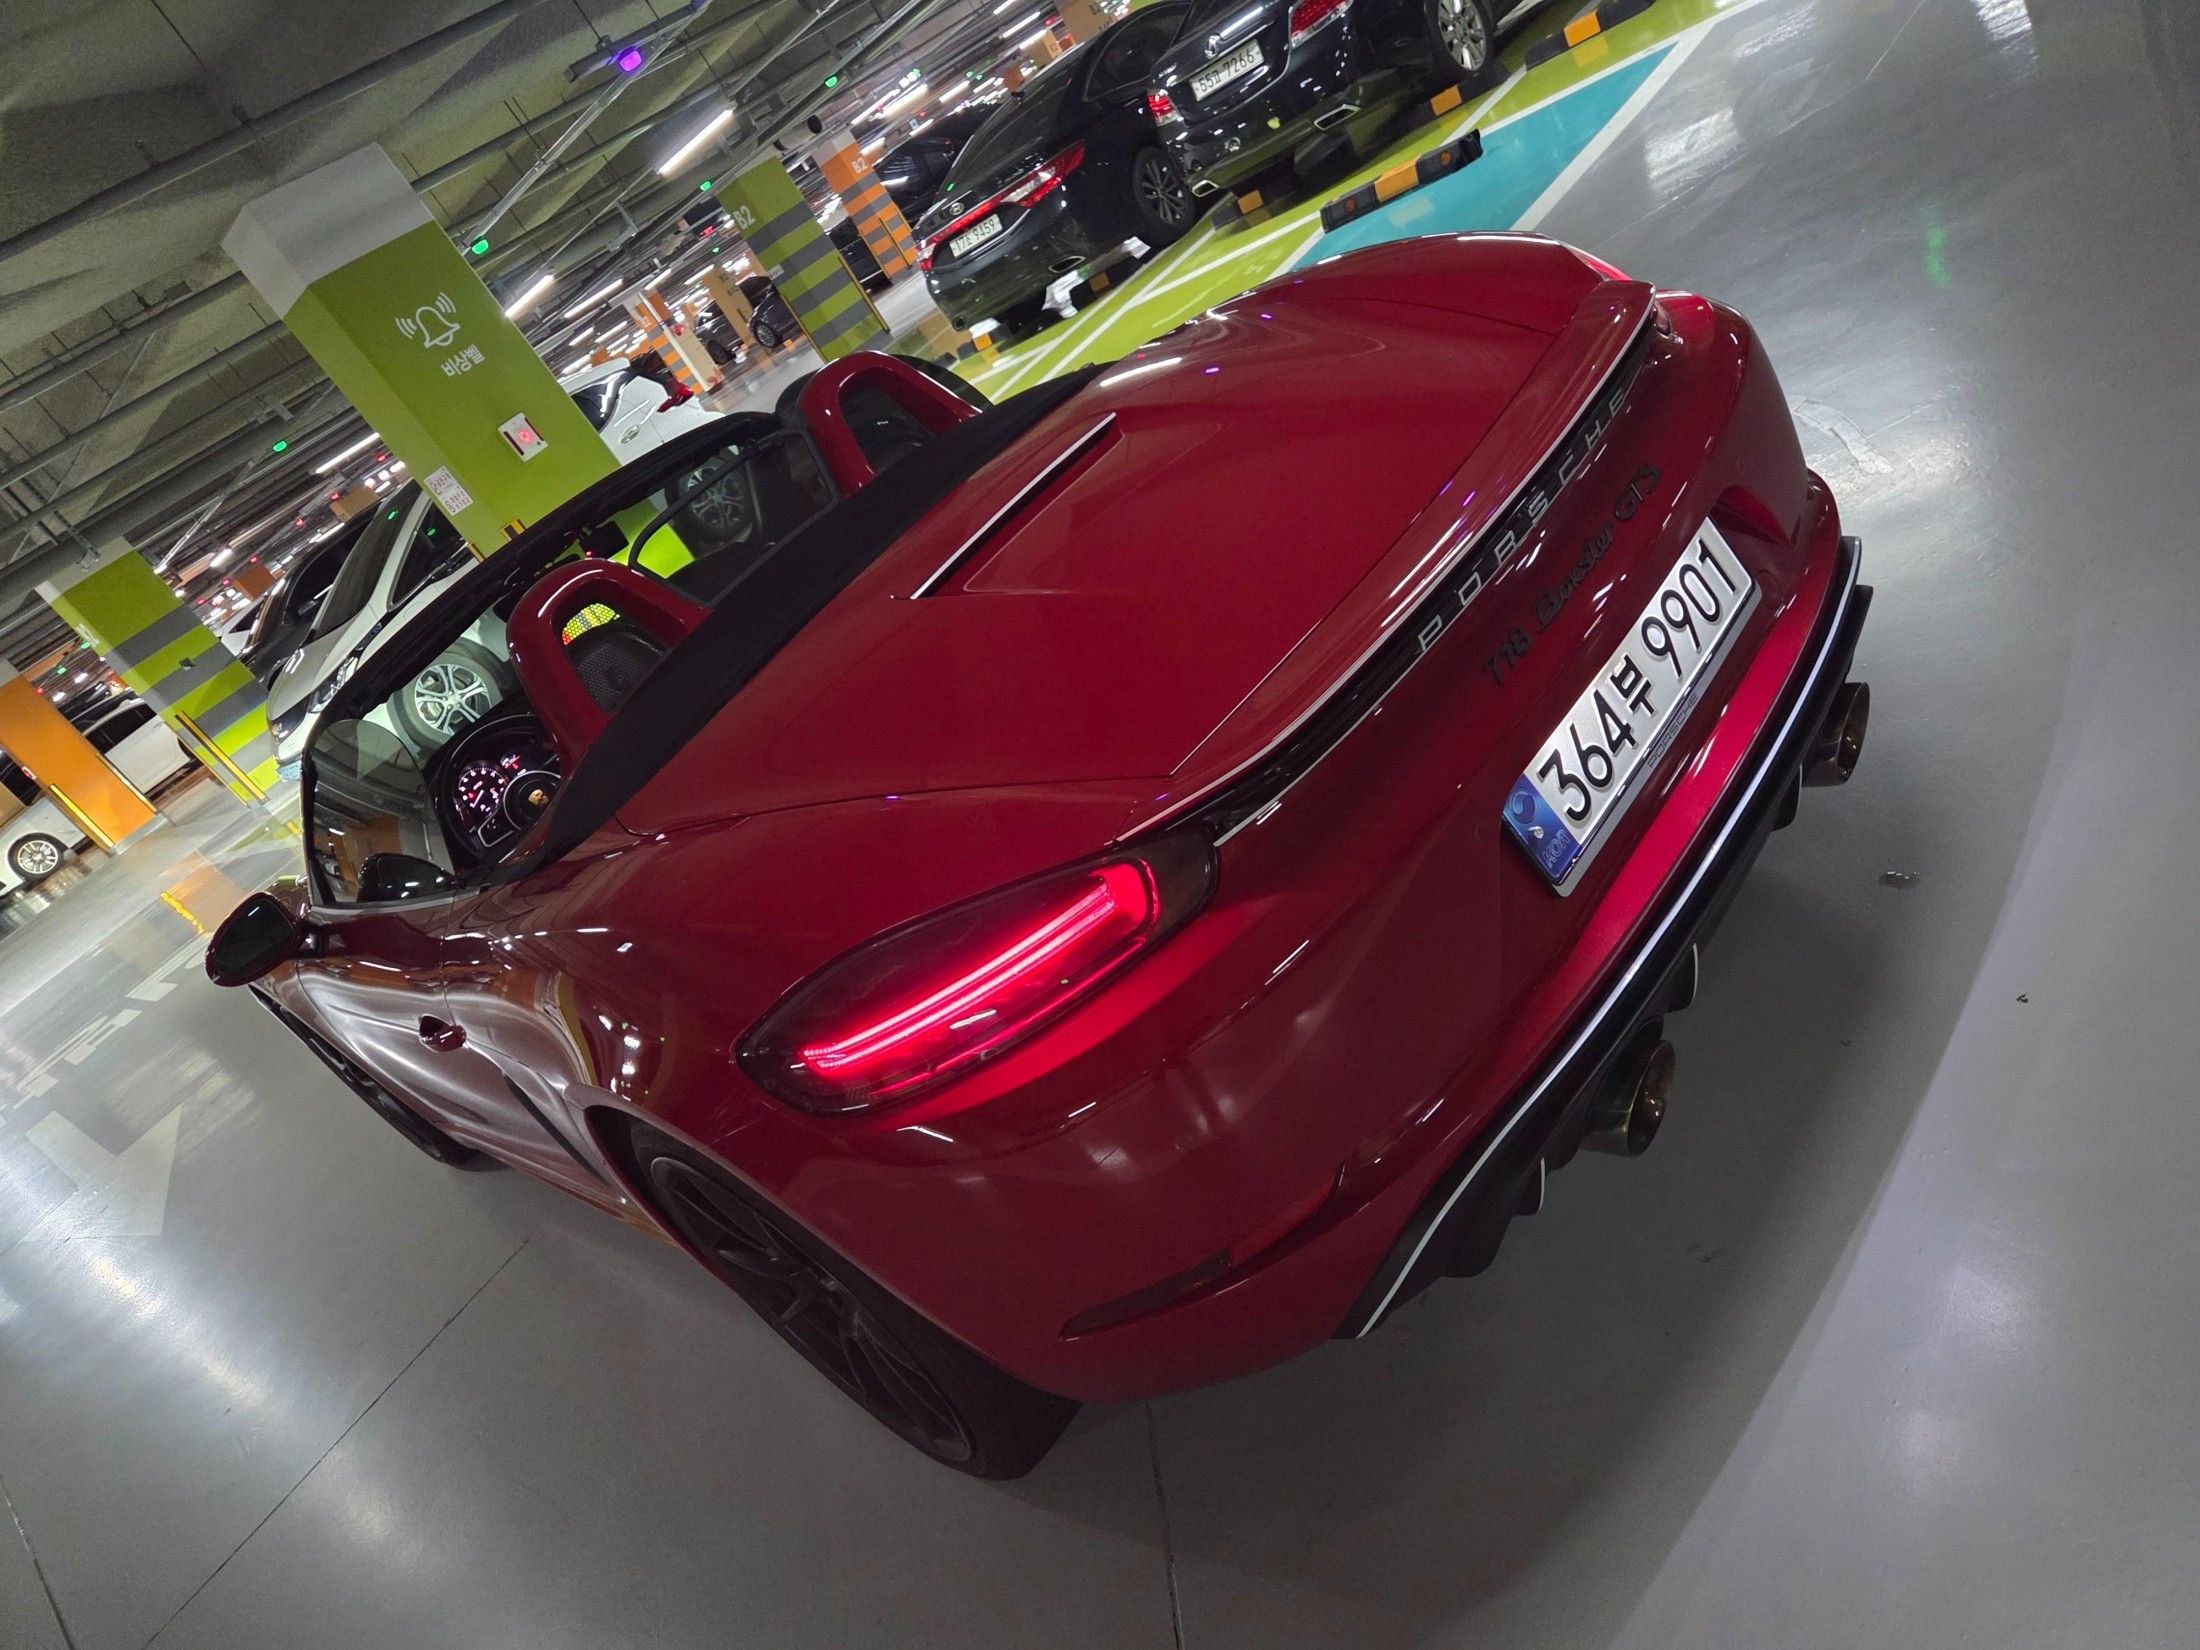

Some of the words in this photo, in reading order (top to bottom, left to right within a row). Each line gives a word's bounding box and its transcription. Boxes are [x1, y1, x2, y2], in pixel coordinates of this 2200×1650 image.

[1223, 48, 1254, 77] 7266
[850, 157, 868, 174] B2
[732, 205, 756, 230] B2
[441, 344, 485, 376] 비상벨
[1417, 388, 1624, 652] PORSCHE
[1482, 627, 1532, 688] 718
[1614, 463, 1660, 522] GTS
[1528, 655, 1654, 821] 364부
[1641, 538, 1736, 678] 9901
[1647, 692, 1697, 769] PORSCHE
[1542, 829, 1570, 868] KOR
